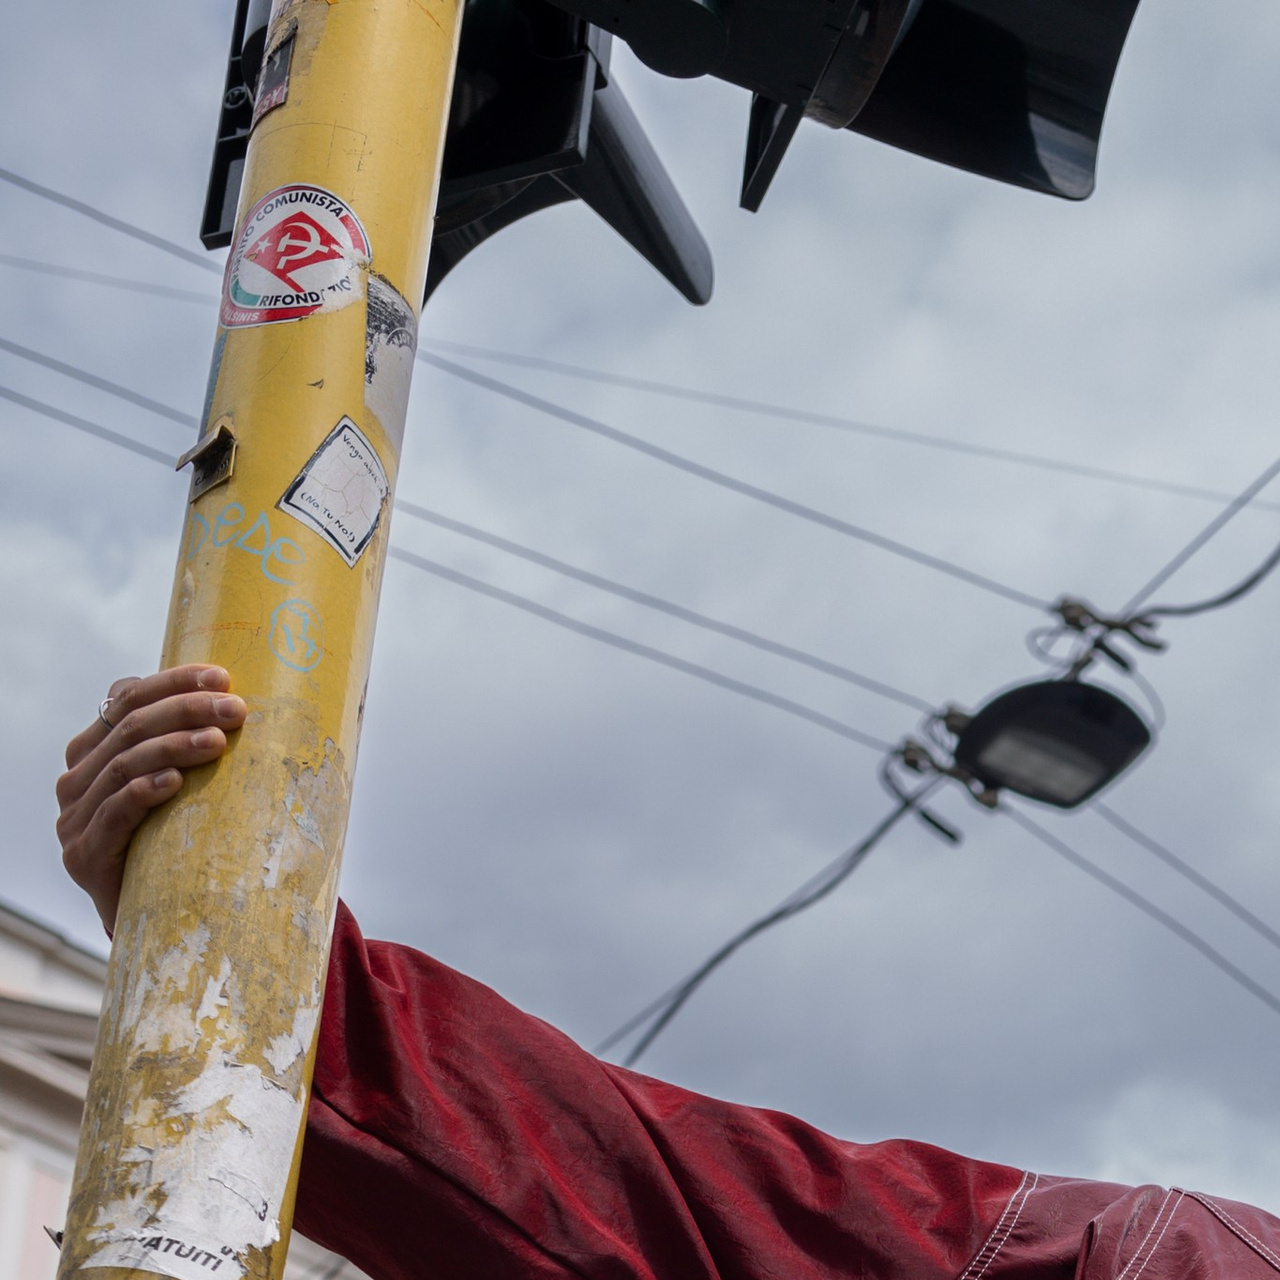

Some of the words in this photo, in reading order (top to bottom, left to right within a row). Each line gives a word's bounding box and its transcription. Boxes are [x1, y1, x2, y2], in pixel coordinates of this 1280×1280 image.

[256, 192, 344, 222] COMUNISTA
[343, 434, 363, 459] Vengo
[133, 1235, 224, 1272] ATUITI
